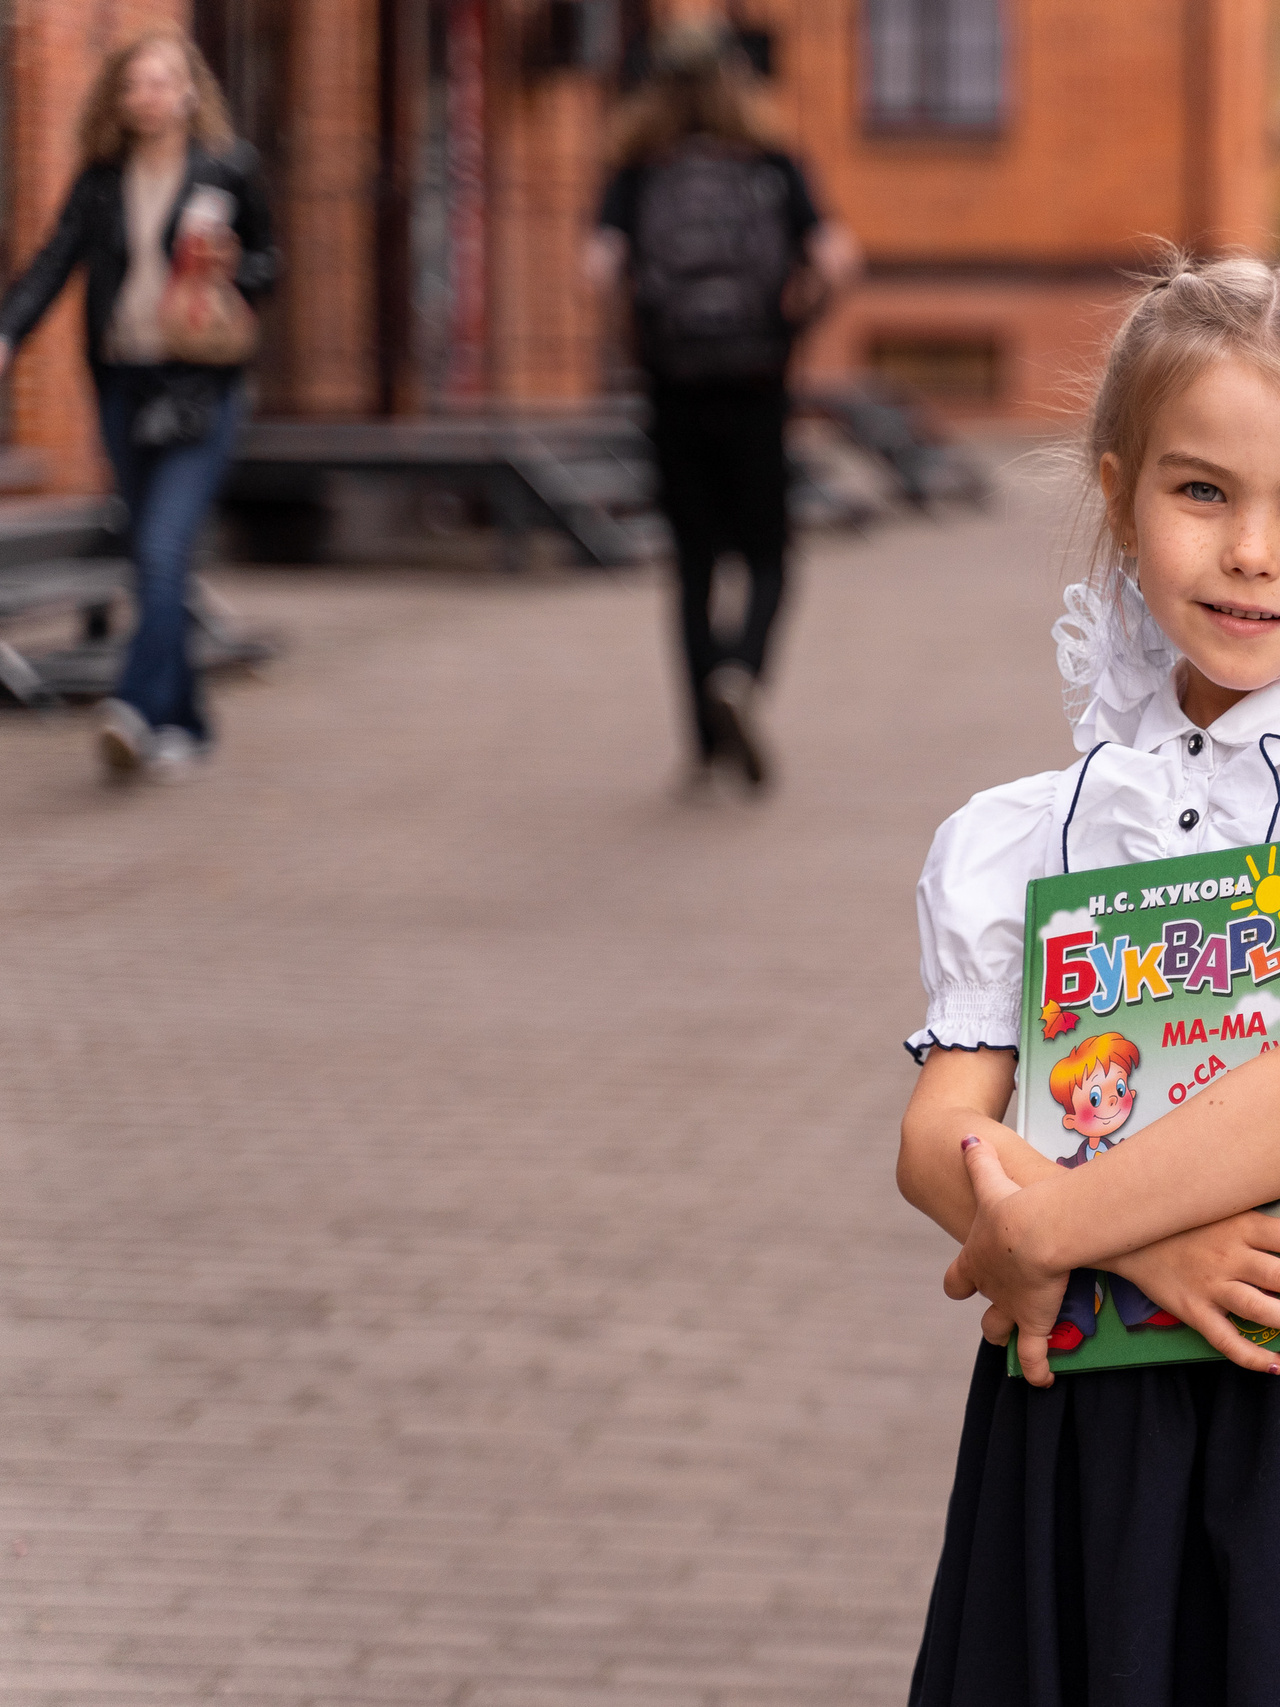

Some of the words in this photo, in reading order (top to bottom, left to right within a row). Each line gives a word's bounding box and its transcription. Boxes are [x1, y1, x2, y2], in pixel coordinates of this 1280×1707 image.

[1140, 874, 1254, 910] ЖУКОВА
[1161, 1011, 1268, 1048] МА-МА
[1168, 1054, 1227, 1105] О-СА
